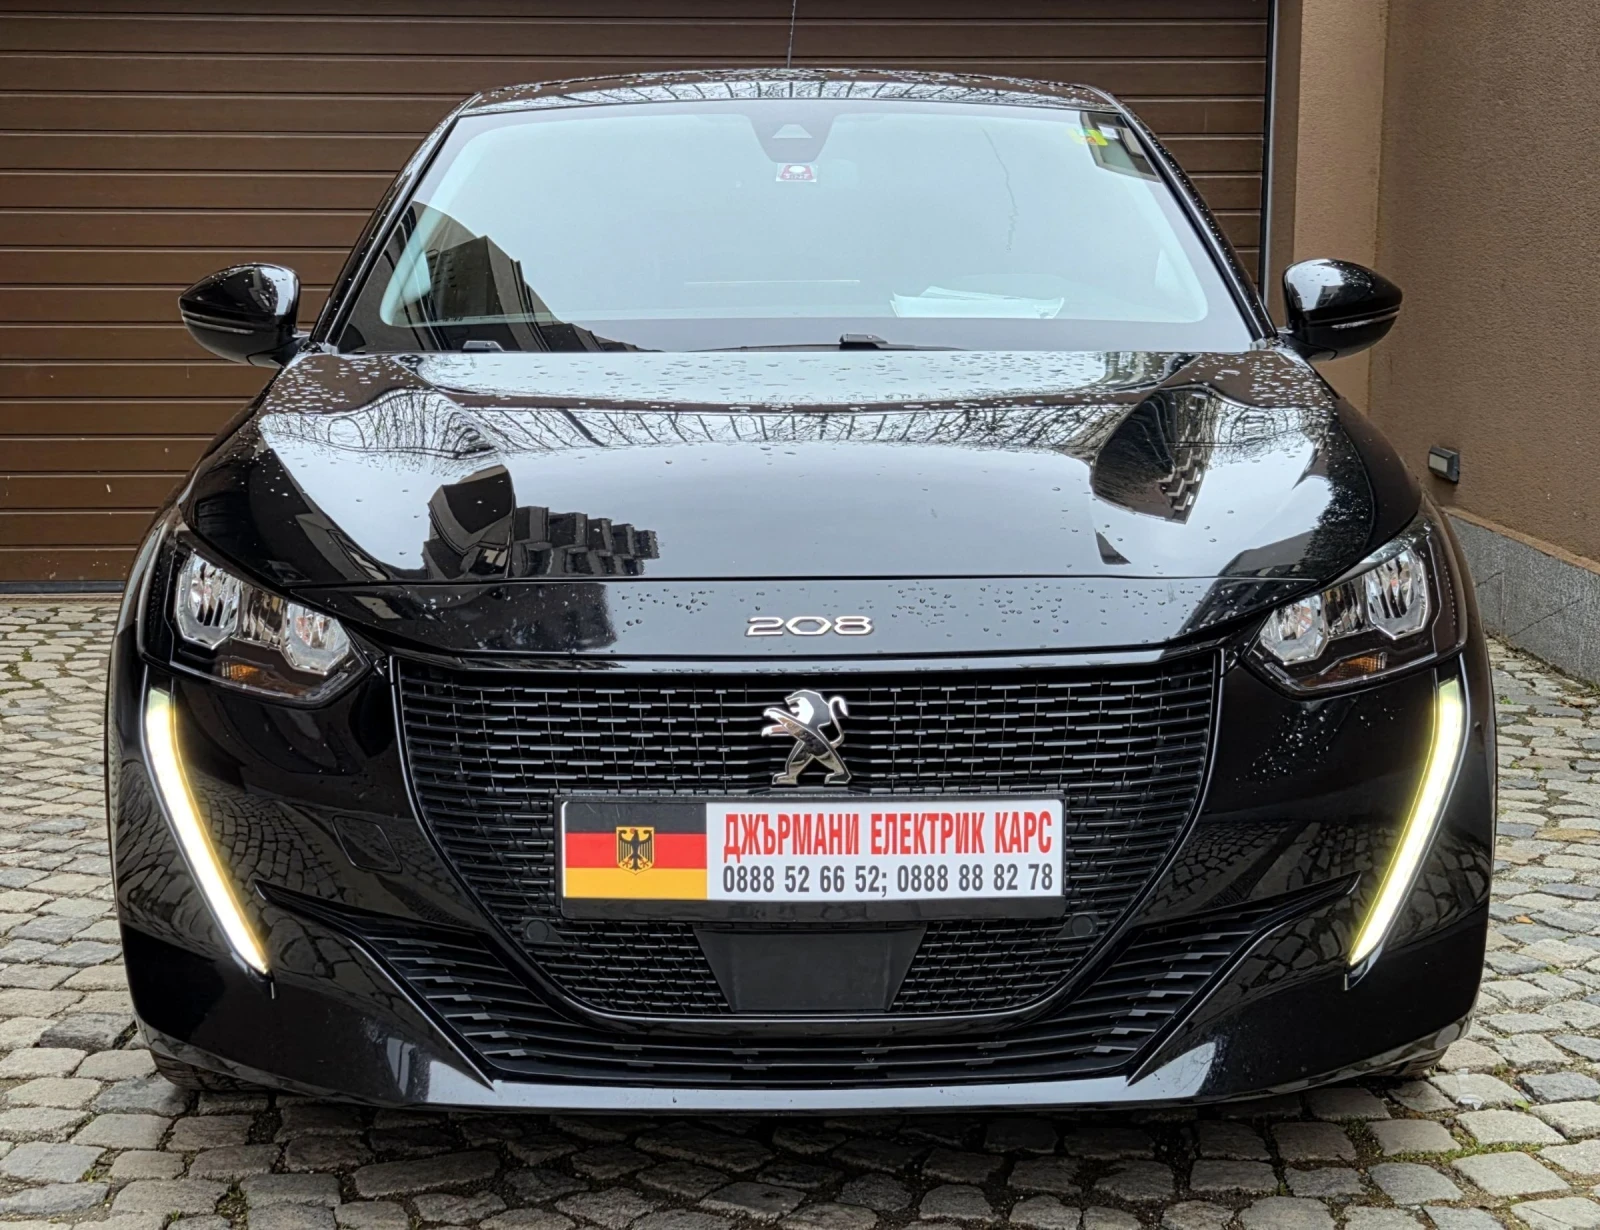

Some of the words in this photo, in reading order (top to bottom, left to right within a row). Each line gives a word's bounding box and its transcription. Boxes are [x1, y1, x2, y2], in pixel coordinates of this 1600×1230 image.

[745, 615, 874, 637] 208
[723, 812, 860, 863] ДЖЪРМАНИ
[870, 811, 985, 856] ЕЛЕКТРИК
[994, 810, 1053, 854] КАРС
[723, 865, 775, 893] 0888
[784, 865, 810, 893] 52
[819, 865, 845, 893] 66
[855, 864, 888, 897] 52;
[897, 864, 949, 893] 0888
[958, 863, 984, 892] 88
[993, 863, 1018, 891] 82
[1028, 863, 1053, 891] 78
